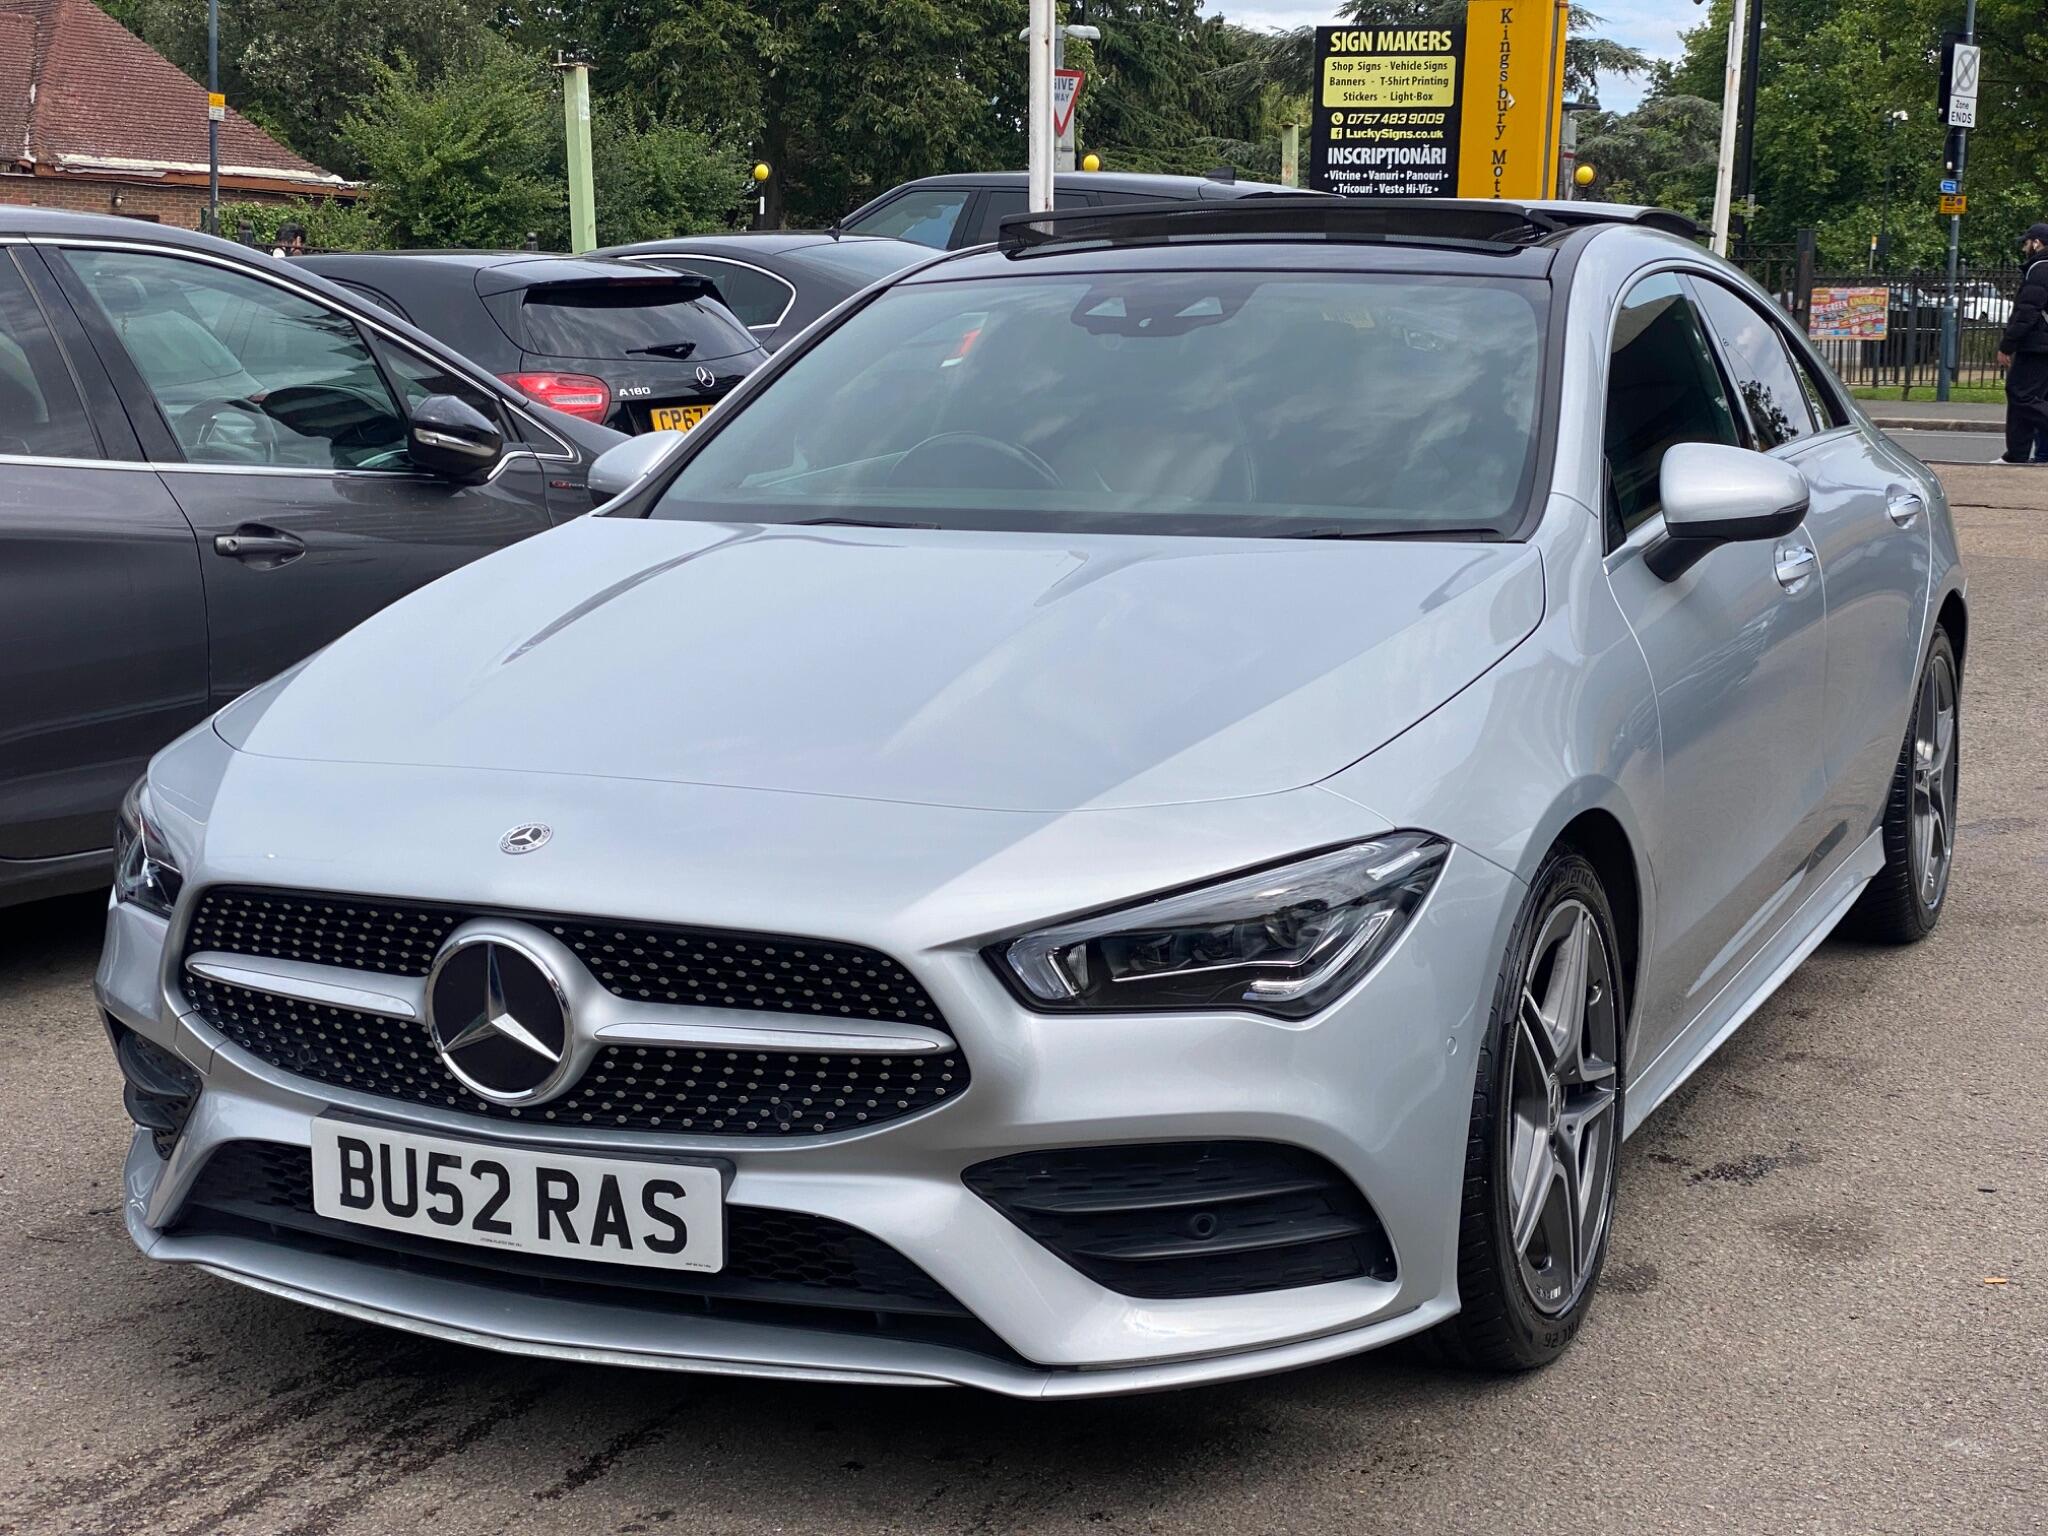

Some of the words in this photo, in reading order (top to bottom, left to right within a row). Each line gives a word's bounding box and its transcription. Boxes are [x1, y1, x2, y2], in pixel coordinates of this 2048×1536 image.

[1330, 31, 1373, 52] SIGN
[1377, 30, 1452, 52] MAKERS
[1331, 61, 1354, 72] Shop
[1357, 61, 1381, 72] Signs
[1390, 60, 1422, 70] Vehicle
[1423, 60, 1448, 72] Signs
[1494, 7, 1514, 140] Kingsbury
[1054, 77, 1074, 90] IVE
[1329, 77, 1366, 86] Banners
[1380, 77, 1410, 85] T-Shirt
[1411, 76, 1449, 87] Printing
[1343, 91, 1378, 101] Stickers
[1390, 91, 1433, 103] Light-Box
[1955, 100, 1969, 109] Zone
[1347, 113, 1380, 125] 0757
[1380, 113, 1408, 125] 483
[1408, 113, 1445, 125] 9009
[1951, 111, 1972, 124] ENDS
[1346, 128, 1443, 142] LuckySigns.co.uk
[1330, 170, 1361, 180] Vitrine
[1368, 170, 1399, 180] Vanuri
[1406, 170, 1443, 180] Panouri
[1491, 149, 1507, 198] Mot
[1338, 183, 1373, 194] Tricouri
[1379, 184, 1405, 194] Veste
[1406, 183, 1433, 194] Hi-Viz
[337, 1135, 512, 1236] BU52
[535, 1166, 688, 1255] RAS
